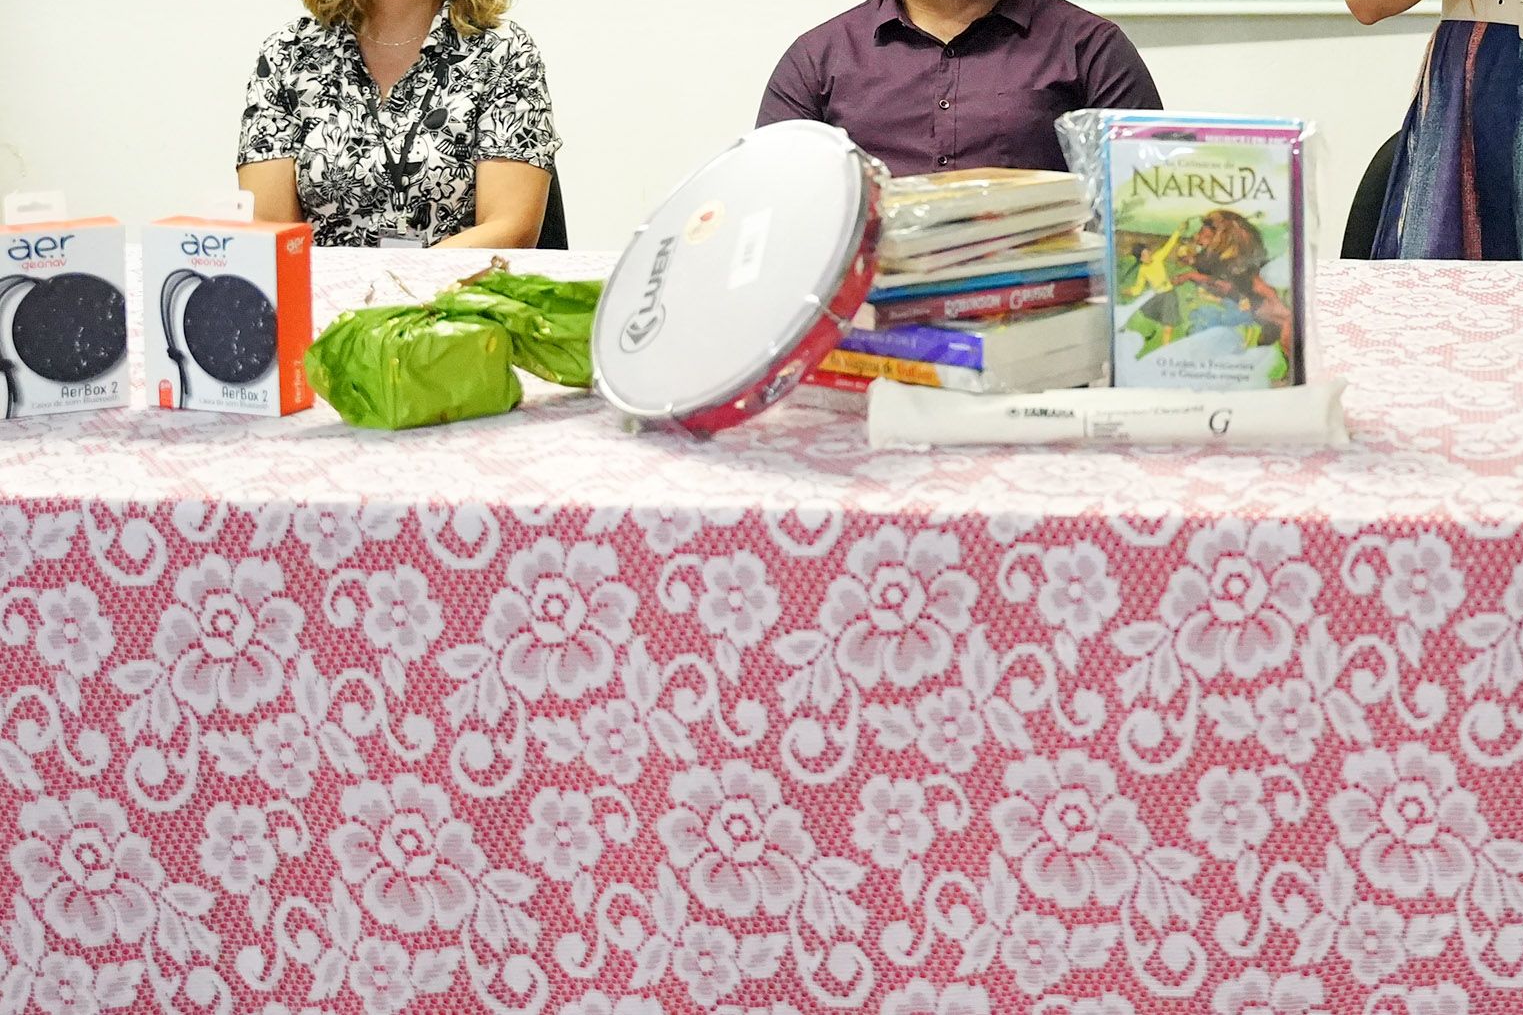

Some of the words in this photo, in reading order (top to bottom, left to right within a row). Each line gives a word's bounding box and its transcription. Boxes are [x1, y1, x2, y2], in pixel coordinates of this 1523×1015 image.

[1132, 166, 1275, 205] NARNIA
[22, 259, 67, 272] geonav
[191, 256, 228, 268] geonav
[639, 237, 675, 315] LUEN
[61, 383, 107, 398] AerBox
[112, 382, 118, 394] 2
[222, 386, 259, 402] AerBox
[263, 390, 268, 402] 2
[1209, 409, 1232, 435] G
